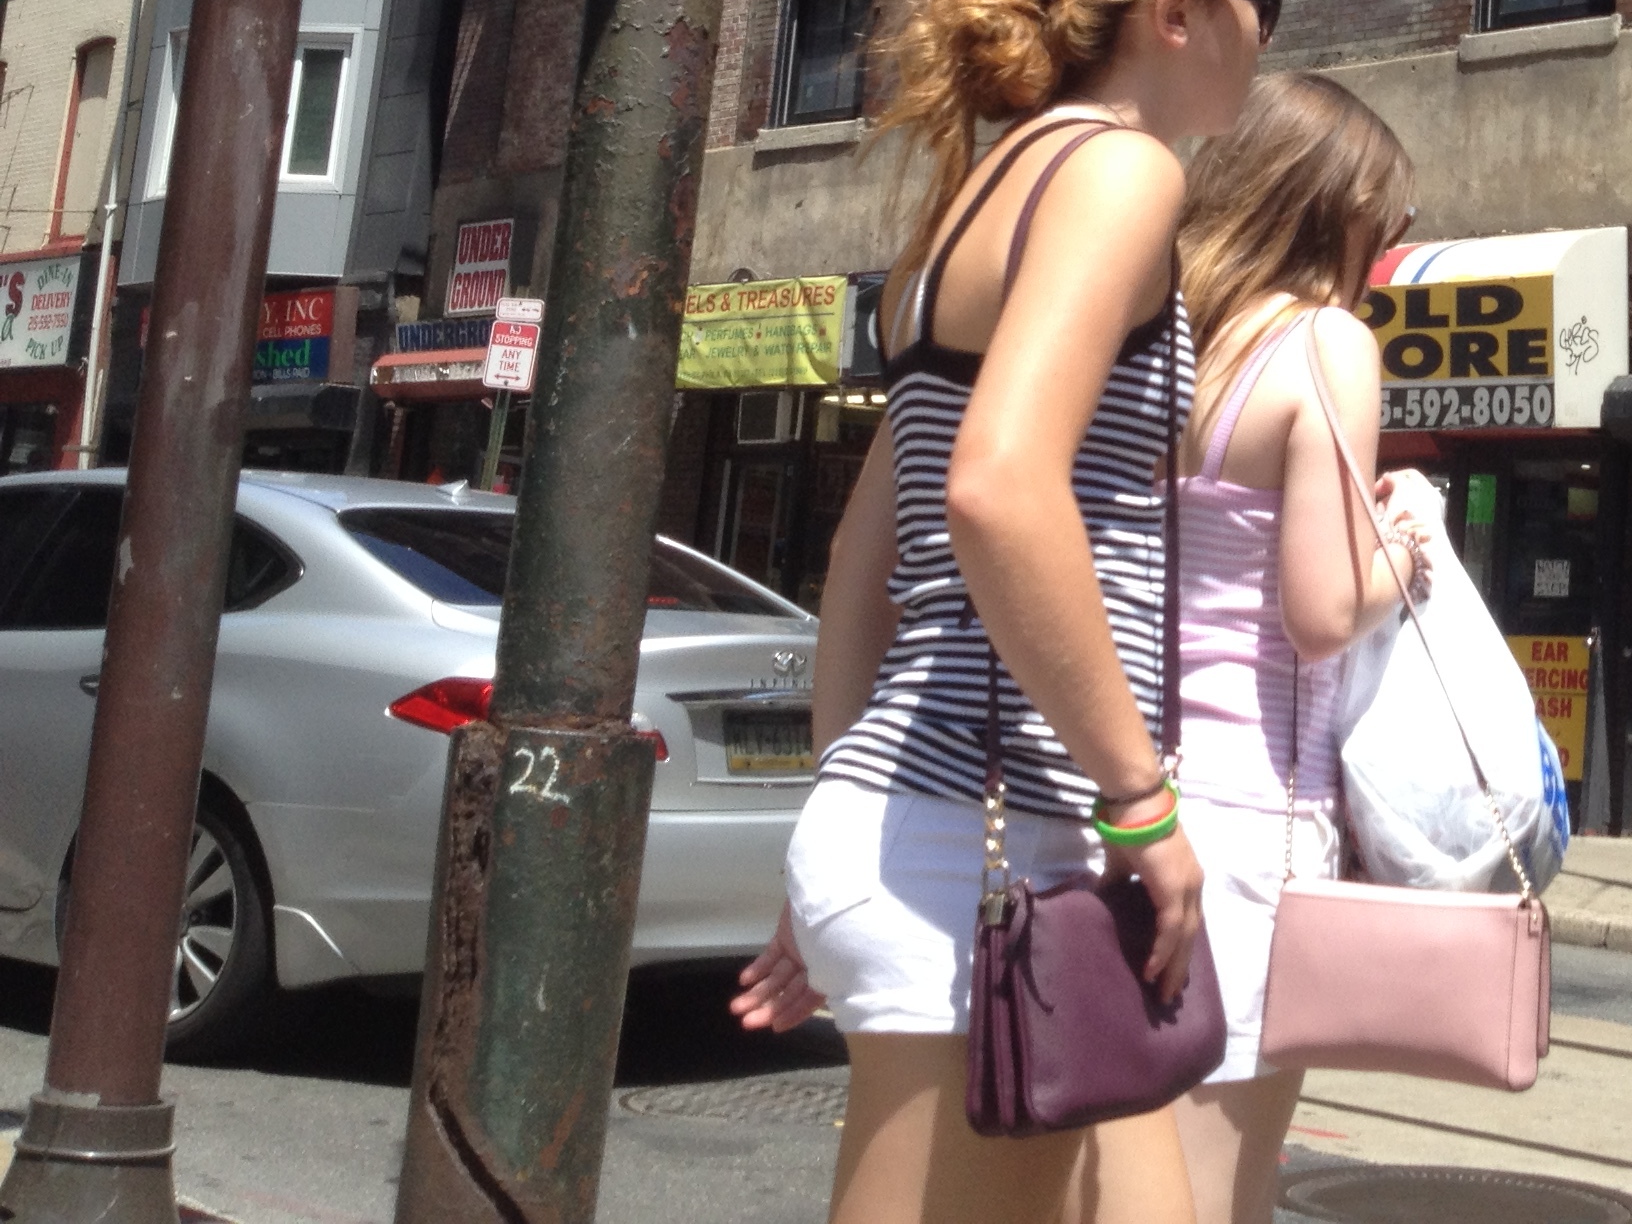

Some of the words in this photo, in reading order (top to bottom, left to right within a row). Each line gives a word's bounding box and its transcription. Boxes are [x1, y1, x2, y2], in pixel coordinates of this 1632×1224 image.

[458, 222, 512, 265] UNDER
[450, 268, 507, 311] GROUND
[720, 293, 731, 312] &
[737, 285, 836, 311] TREASURES
[31, 291, 73, 311] DELIVERY
[286, 297, 324, 322] INC
[1356, 284, 1524, 330] OLD
[284, 323, 322, 337] PHONES
[495, 333, 533, 346] STOPPING
[705, 327, 754, 341] PERFUMES
[501, 348, 522, 359] ANY
[499, 361, 520, 372] TIME
[1532, 641, 1569, 662] EAR
[1535, 697, 1572, 718] ASH
[509, 745, 570, 804] 22
